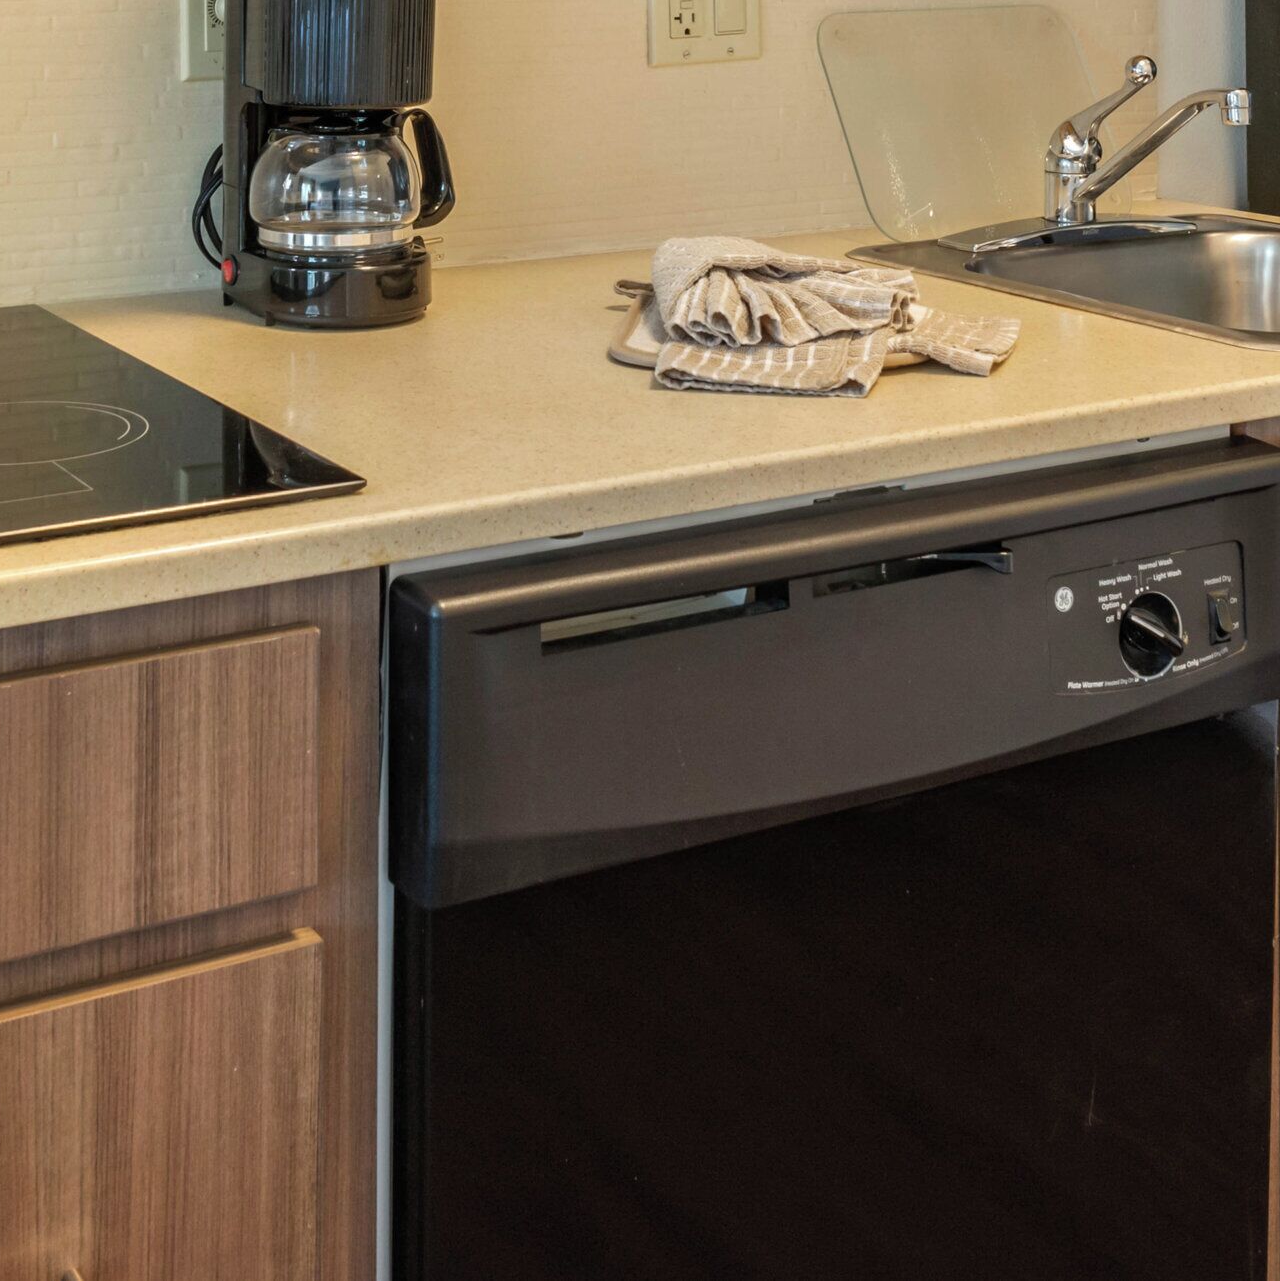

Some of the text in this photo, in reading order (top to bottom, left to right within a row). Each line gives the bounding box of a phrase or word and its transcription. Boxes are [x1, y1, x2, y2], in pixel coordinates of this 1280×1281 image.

[1138, 558, 1174, 570] Normal Wash
[1098, 574, 1132, 586] Heavy Wash
[1153, 570, 1182, 582] Light Wash
[1204, 574, 1232, 586] Heated Dry
[1098, 592, 1122, 603] Hot Start
[1102, 601, 1120, 610] Option
[1106, 614, 1114, 624] Off
[1186, 658, 1200, 668] Only
[1068, 681, 1082, 689] Plate
[1082, 681, 1104, 689] Warmer
